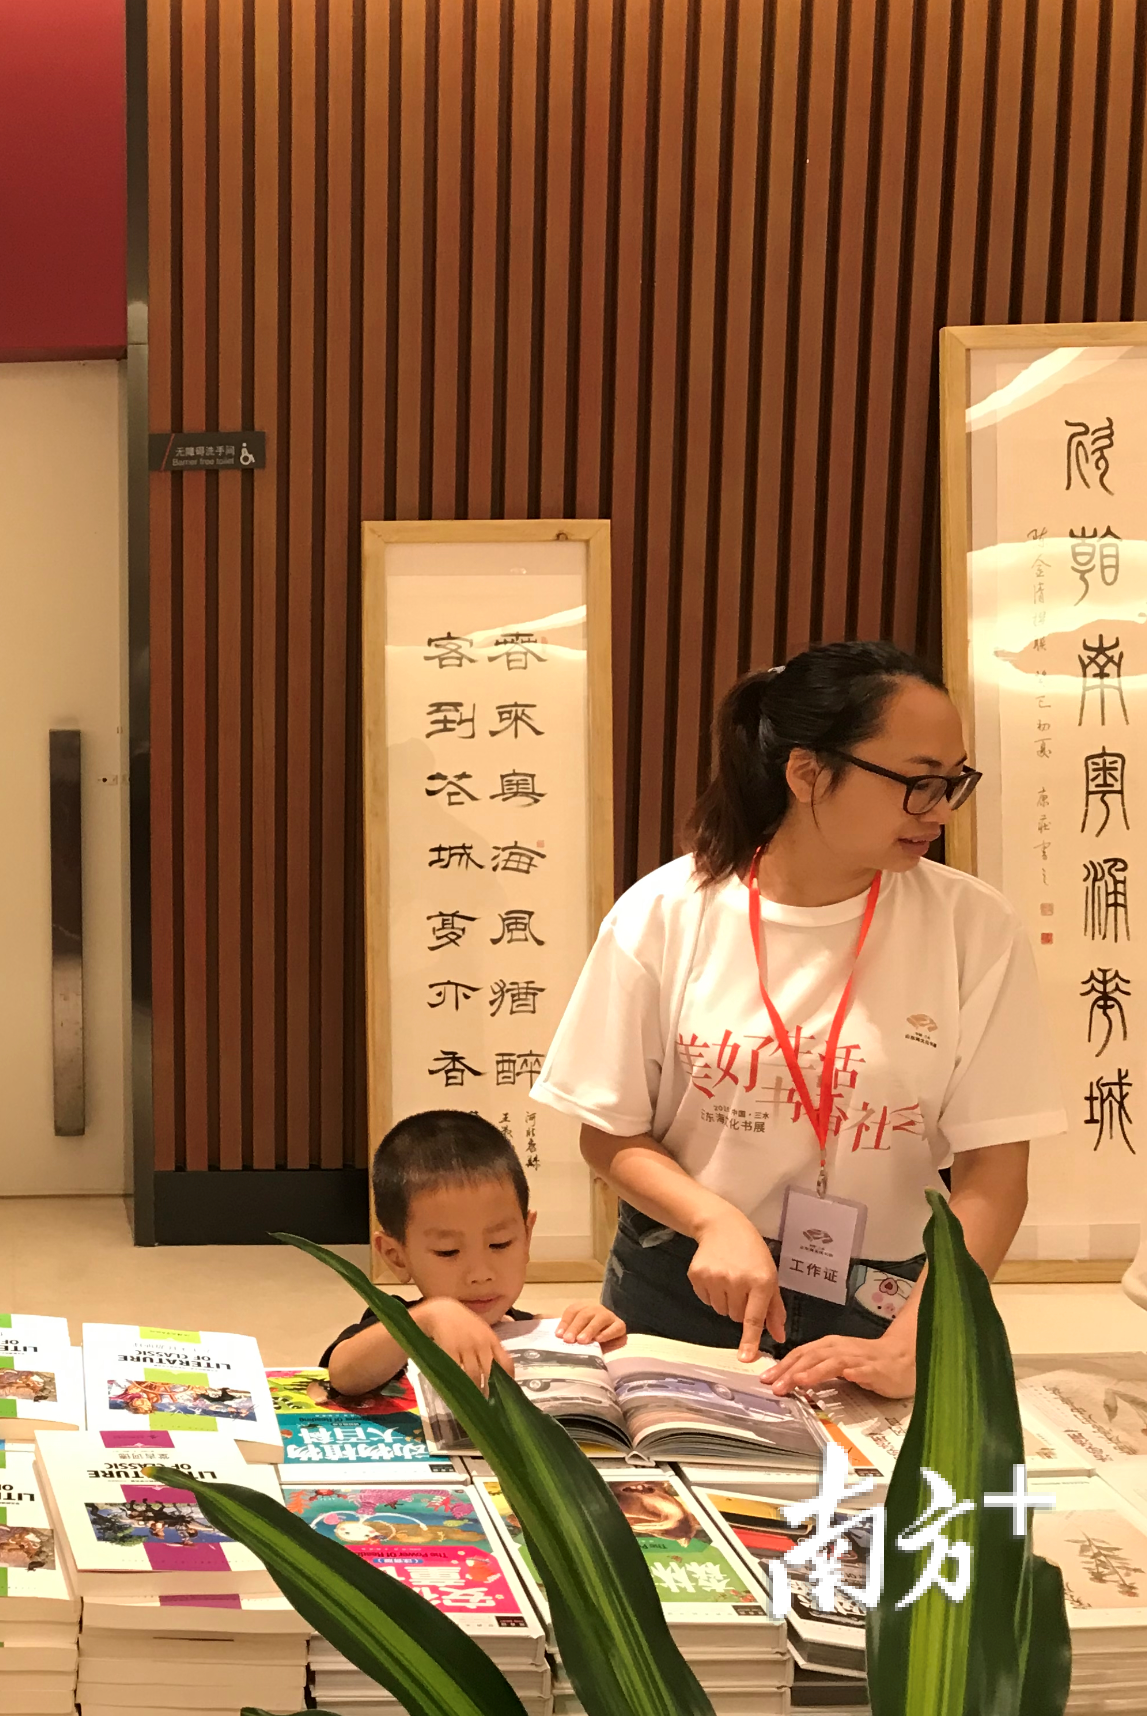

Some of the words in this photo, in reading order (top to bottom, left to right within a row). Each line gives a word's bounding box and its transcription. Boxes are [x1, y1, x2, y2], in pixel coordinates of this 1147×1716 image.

[175, 445, 236, 457] 无障碍洗手间
[676, 1025, 867, 1099] 美好生活
[789, 1258, 839, 1284] 工作证
[117, 1354, 231, 1370] LITERATURE
[134, 1350, 188, 1360] CLASSIC
[298, 1426, 404, 1444] 大百科
[286, 1443, 430, 1461] 动物植物
[86, 1469, 217, 1480] LITURE
[650, 1561, 735, 1593] 森林
